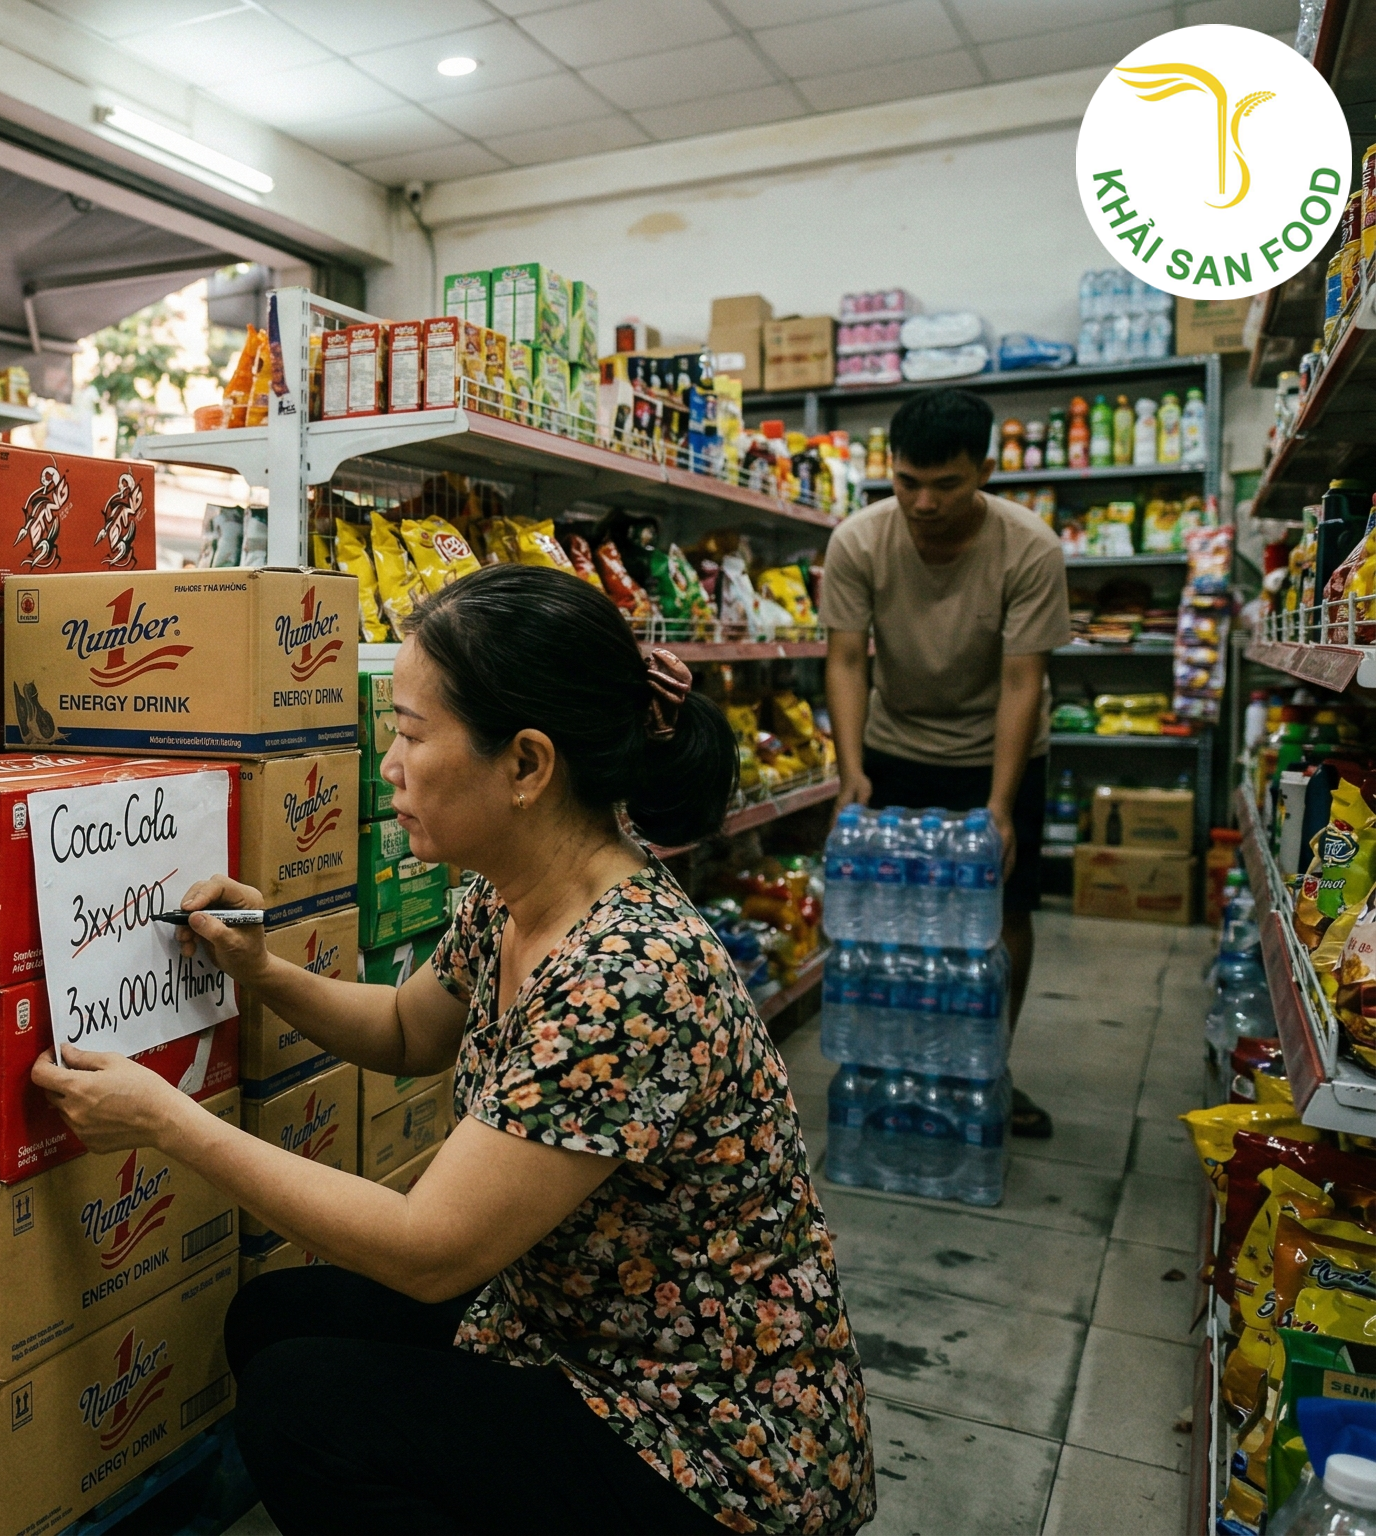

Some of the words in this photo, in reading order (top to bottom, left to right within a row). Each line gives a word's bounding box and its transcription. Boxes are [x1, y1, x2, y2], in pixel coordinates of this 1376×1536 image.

[59, 694, 128, 712] ENERGY
[133, 696, 190, 713] DRINK
[274, 690, 313, 707] ENERGY
[315, 688, 344, 704] DRINK
[50, 786, 178, 864] Coca-Cola
[278, 857, 315, 881] ENERGY
[318, 850, 344, 869] DRINK
[81, 1269, 131, 1310] ENERGY
[133, 1246, 170, 1281] DRINK
[81, 1448, 129, 1493] ENERGY
[132, 1420, 169, 1458] DRINK
